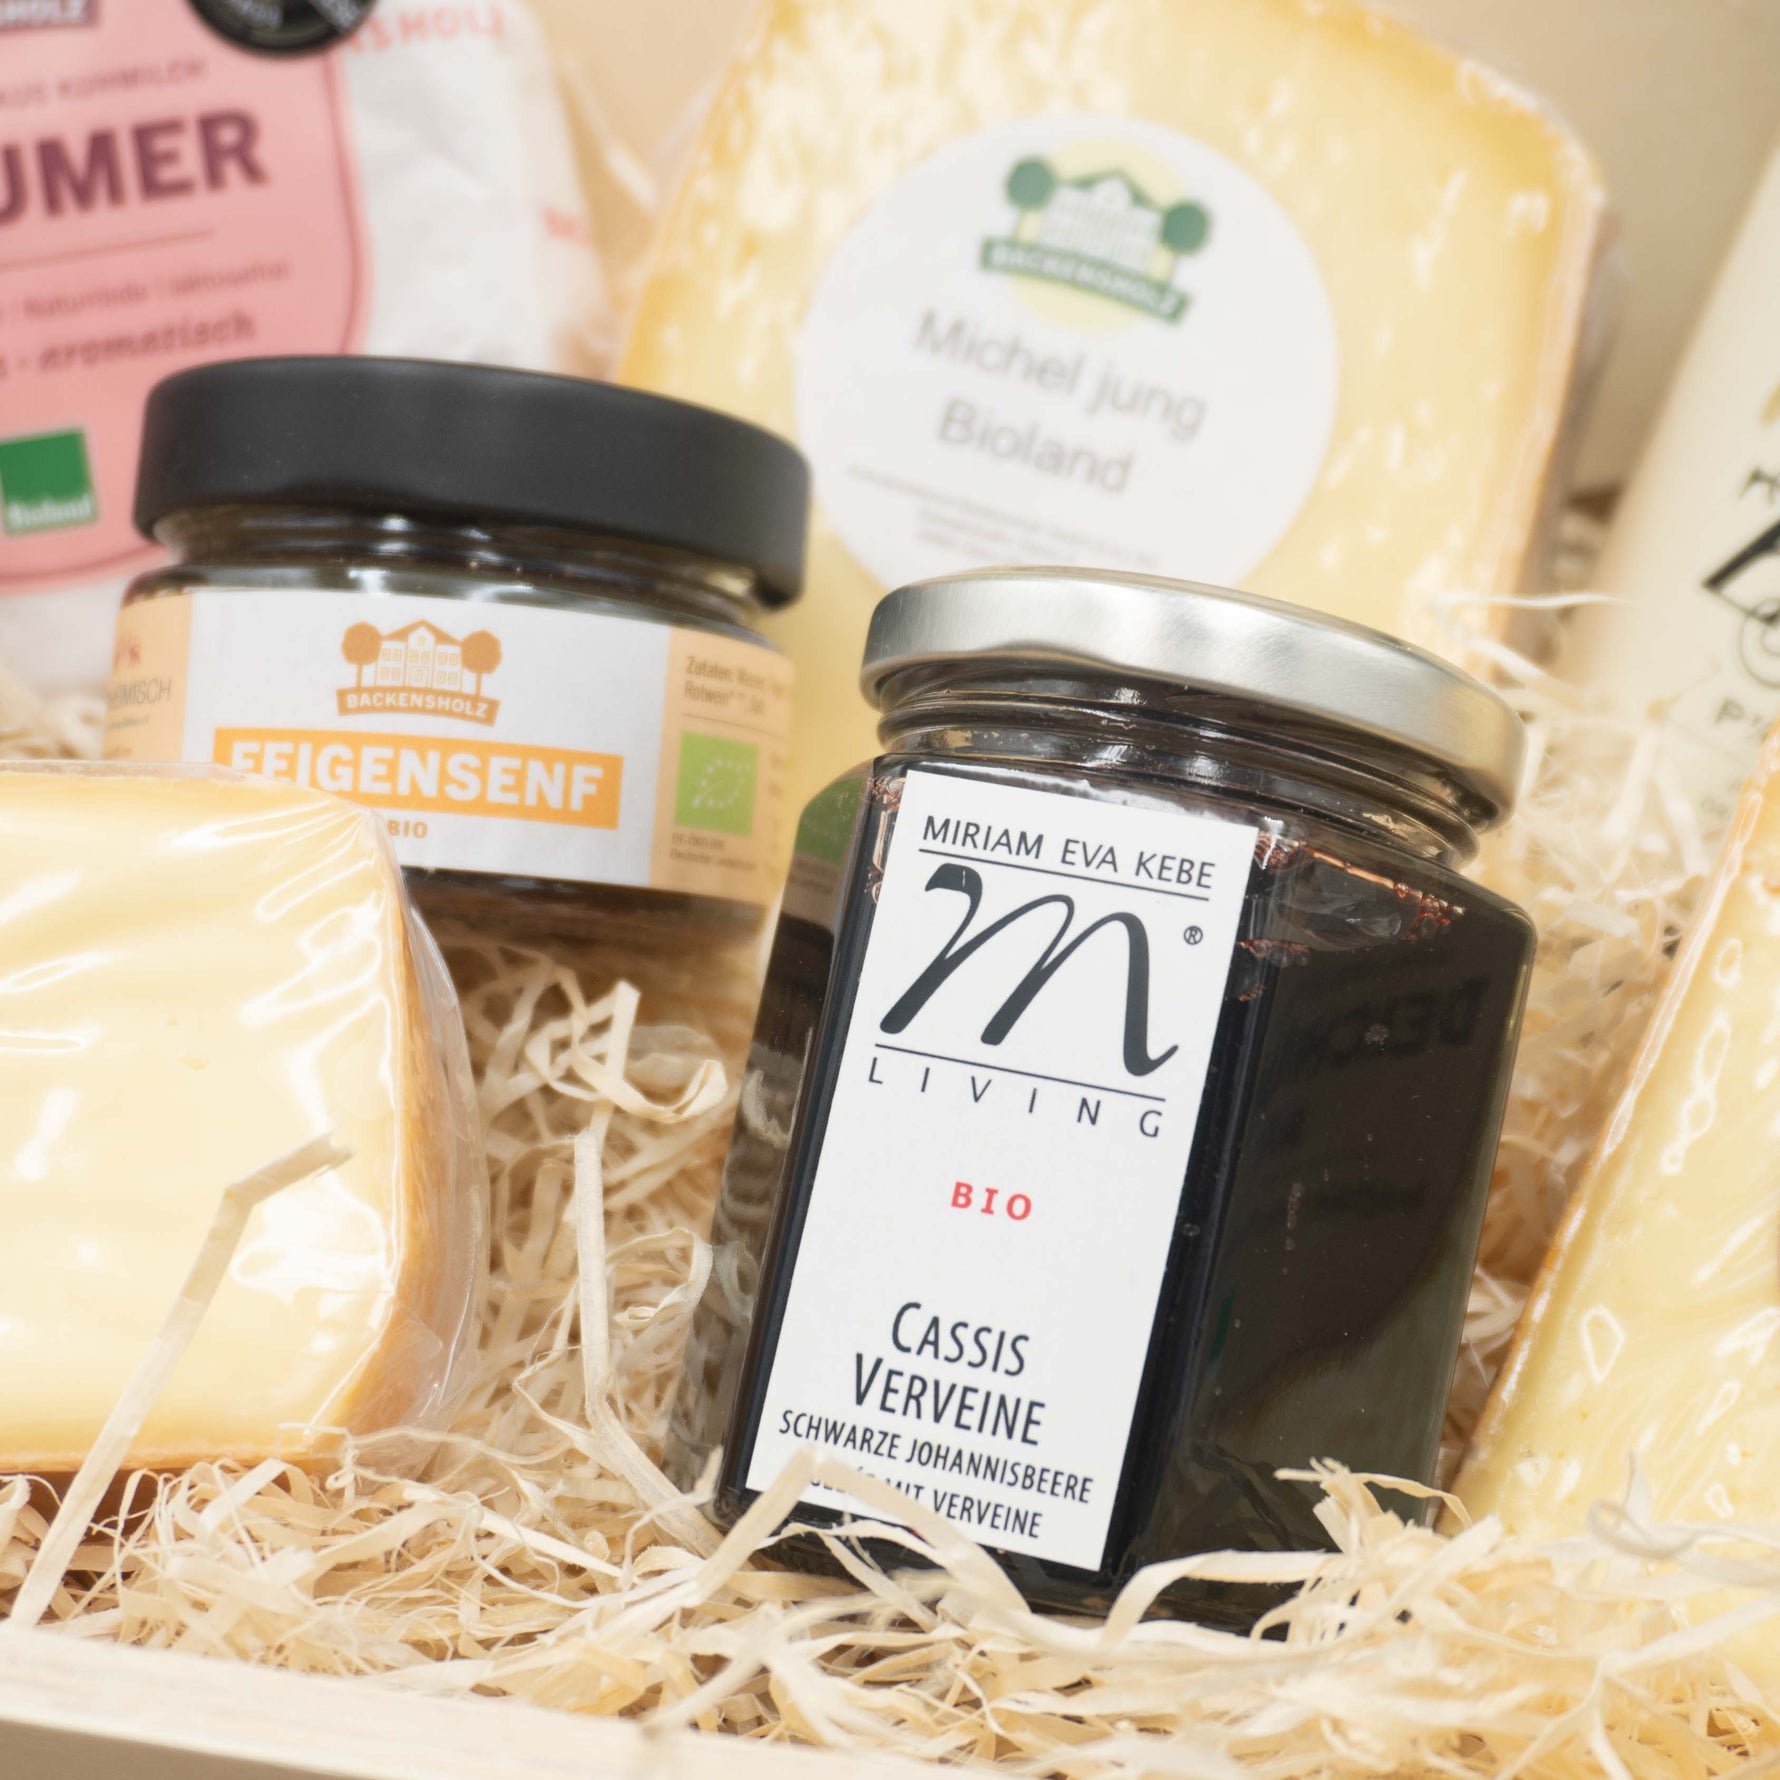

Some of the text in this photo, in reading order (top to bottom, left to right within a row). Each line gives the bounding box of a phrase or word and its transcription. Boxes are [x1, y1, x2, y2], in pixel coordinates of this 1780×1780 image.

[989, 245, 1182, 317] BACKENSHOLZ
[914, 307, 1208, 442] Michel jung
[937, 398, 1138, 495] Bioland
[346, 692, 490, 719] BACKENSHOLZ
[231, 741, 603, 811] FEIGENSENF
[387, 820, 428, 839] BIO
[922, 815, 1216, 889] MIRIAM EVA KEBE
[867, 1057, 1162, 1138] LIVING
[950, 1181, 1032, 1220] BIO
[891, 1301, 1030, 1377] CASSIS
[853, 1352, 1046, 1446] VERVEINE
[779, 1409, 902, 1459] SCHWARZE
[905, 1437, 1094, 1504] JOHANNISBEERE
[932, 1488, 1043, 1540] VERVEINE
